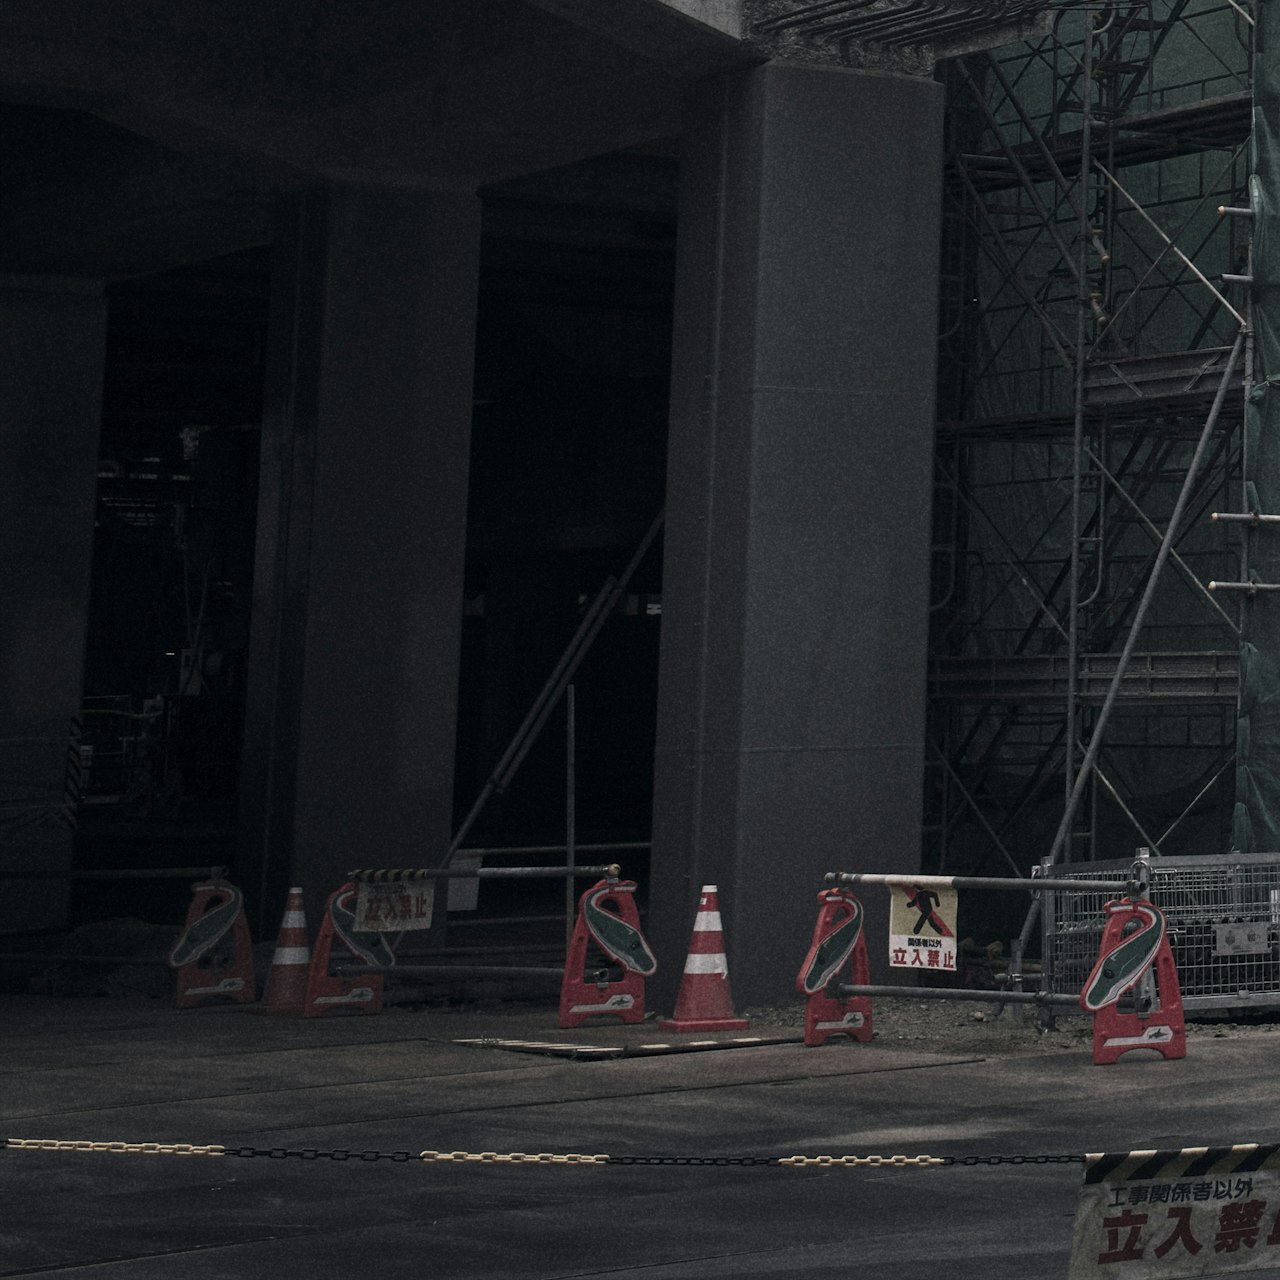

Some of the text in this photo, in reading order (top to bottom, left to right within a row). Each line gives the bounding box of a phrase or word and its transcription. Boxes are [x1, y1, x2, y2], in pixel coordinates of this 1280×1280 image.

[908, 937, 942, 949] 関係者以外
[893, 948, 954, 969] 立入禁止
[1107, 1177, 1254, 1208] 工事関係者以外
